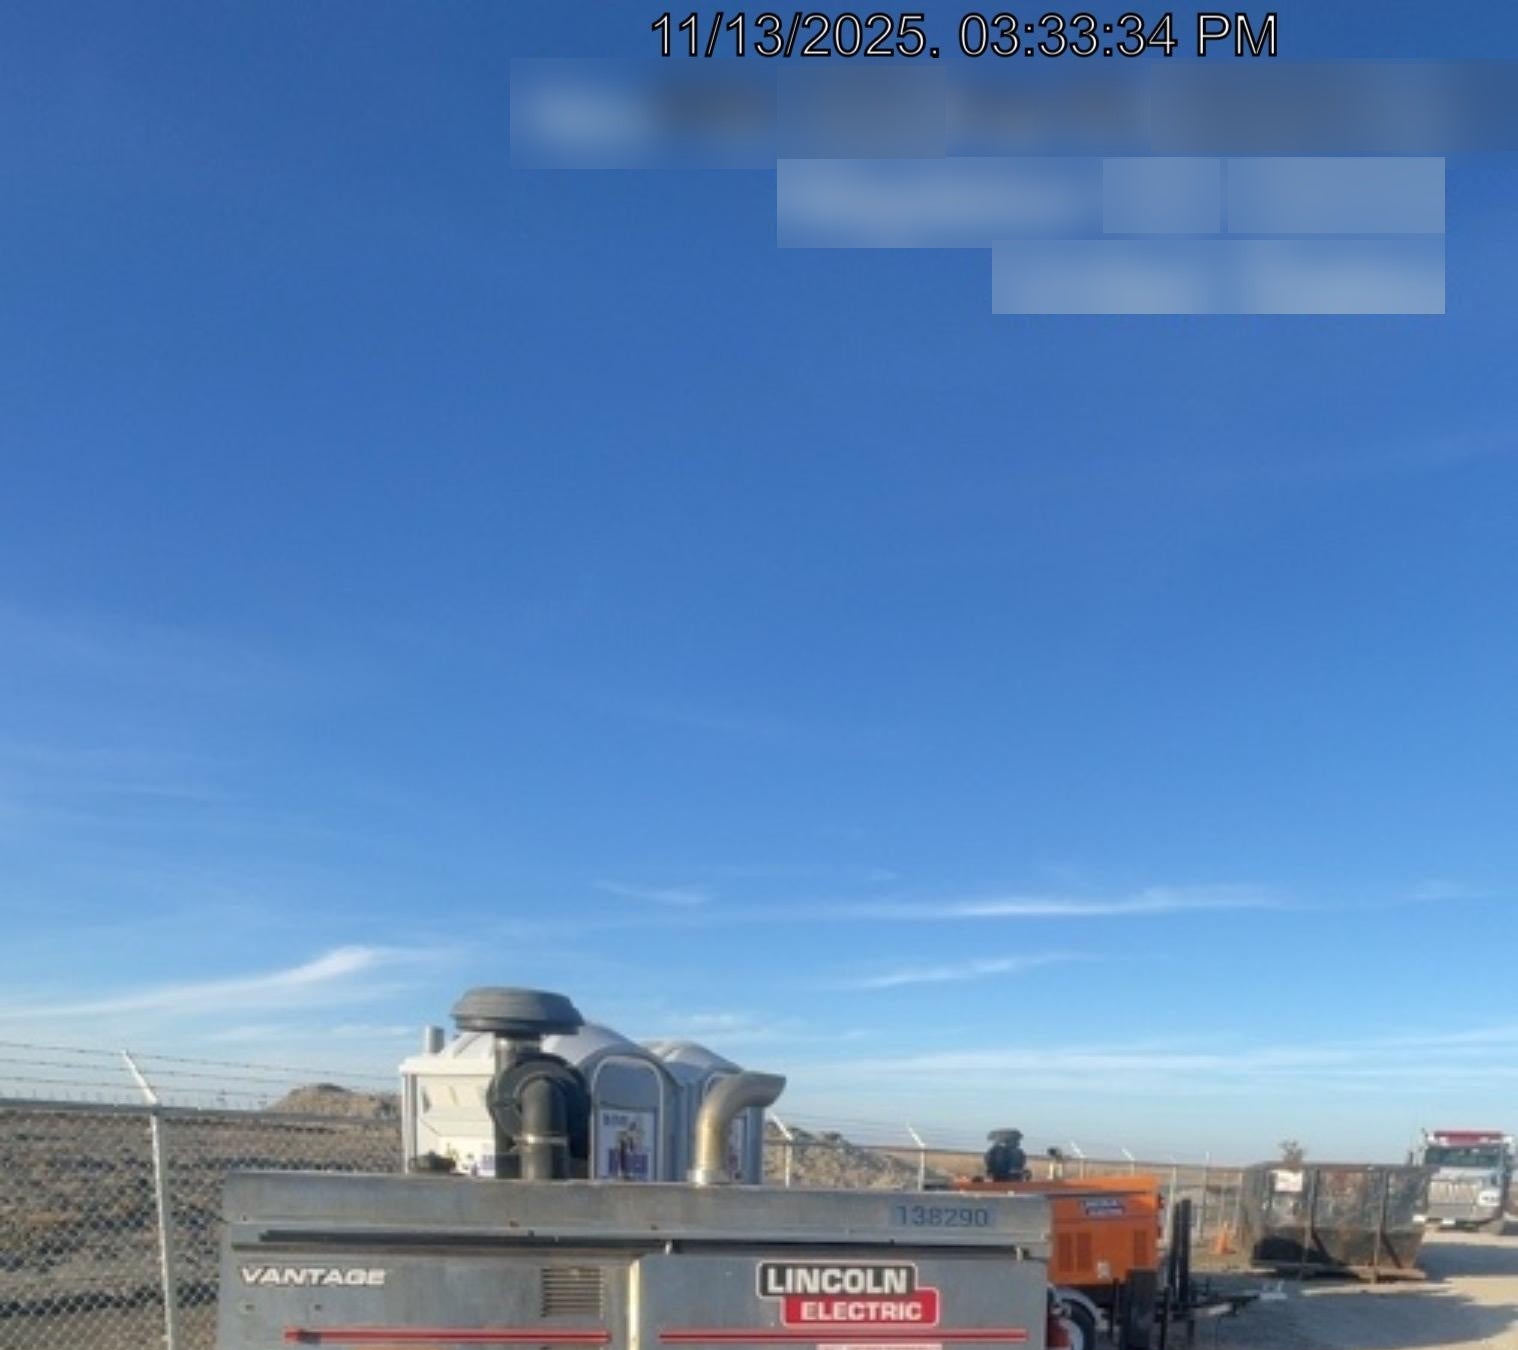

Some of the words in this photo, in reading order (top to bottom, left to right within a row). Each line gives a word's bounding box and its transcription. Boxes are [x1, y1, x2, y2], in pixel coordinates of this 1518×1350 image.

[896, 1205, 988, 1227] 138290
[241, 1266, 385, 1286] VANTAGE
[767, 1267, 907, 1294] LINCOLN
[801, 1301, 923, 1321] ELECTRIC
